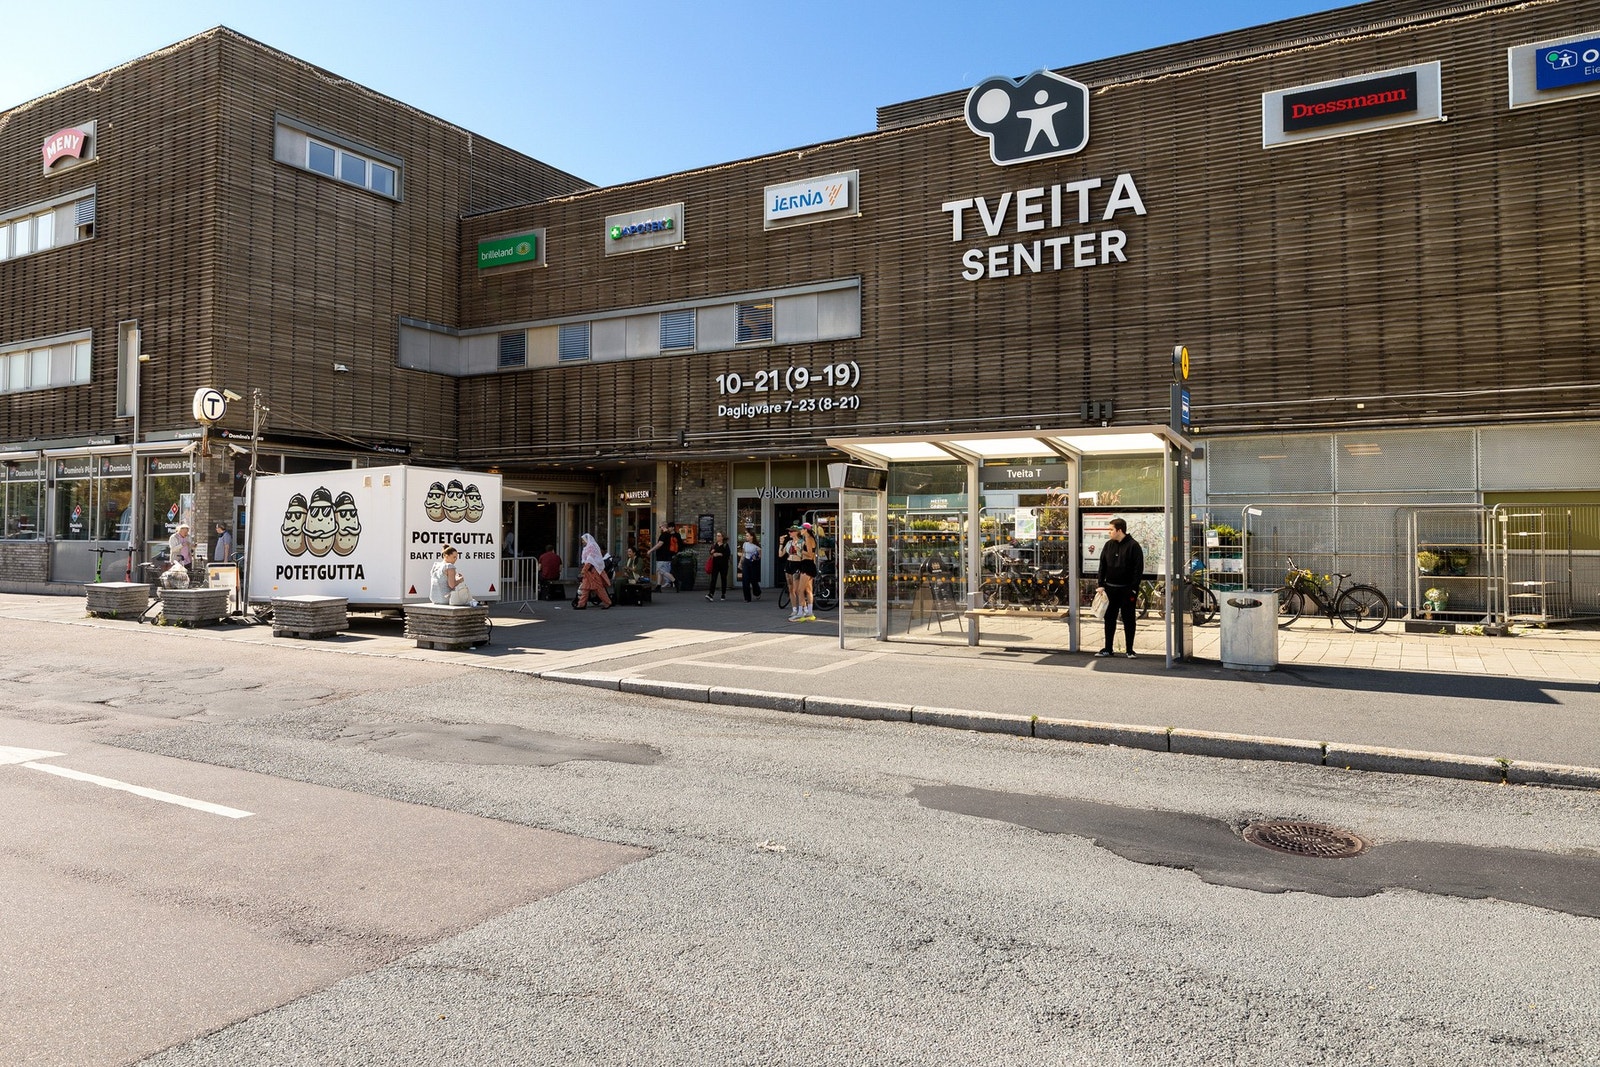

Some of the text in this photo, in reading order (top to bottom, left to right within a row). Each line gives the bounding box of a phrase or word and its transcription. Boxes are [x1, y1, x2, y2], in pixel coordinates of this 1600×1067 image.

[1292, 88, 1407, 119] Dressmann
[46, 134, 80, 160] MENY
[941, 173, 1148, 242] TVEITA
[621, 219, 665, 236] APOTEK
[481, 246, 514, 261] brilleland
[961, 229, 1128, 281] SENTER
[715, 360, 861, 395] 10-21 (9-19)
[207, 397, 220, 416] T
[718, 394, 860, 419] Dagligvare 7-23 (8-21)
[228, 432, 250, 440] Domino's
[63, 465, 84, 474] Domino's
[109, 462, 131, 472] Domino's
[157, 460, 181, 470] Domino's
[1006, 468, 1042, 478] Tveita T
[626, 490, 650, 499] NARVESEN
[755, 486, 830, 499] Velkommen
[412, 531, 494, 545] POTETGUTTA
[410, 551, 496, 560] BAKT POT & FRIES
[276, 564, 365, 580] POTETGUTTA
